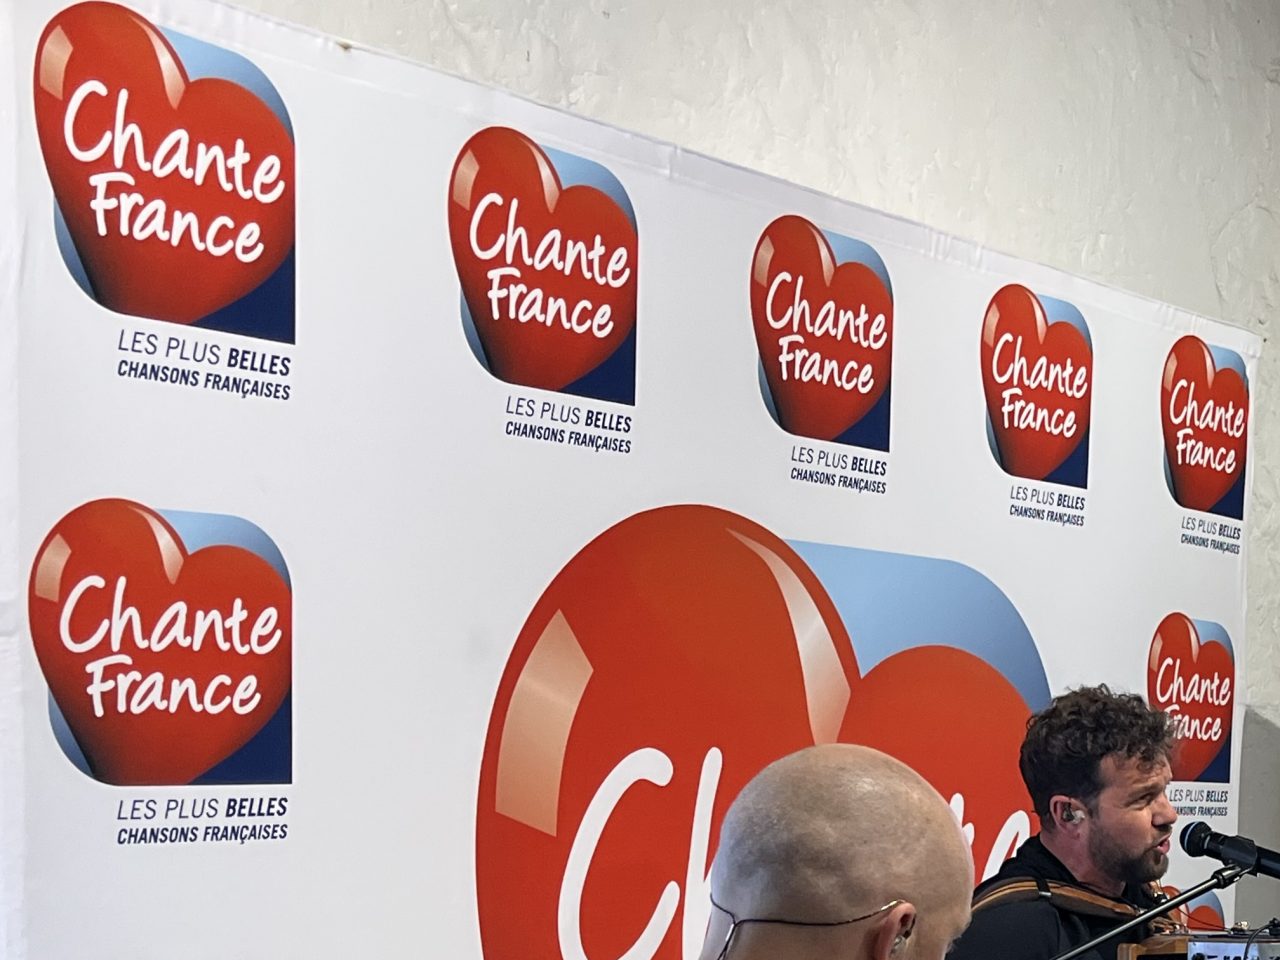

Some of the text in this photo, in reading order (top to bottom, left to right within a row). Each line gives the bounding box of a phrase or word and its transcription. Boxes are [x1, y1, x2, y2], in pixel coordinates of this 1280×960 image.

[64, 80, 285, 203] Chante
[89, 172, 264, 263] France
[469, 192, 630, 288] Chante
[487, 267, 614, 338] France
[766, 272, 888, 350] Chante
[118, 329, 291, 376] LES PLUS BELLES
[778, 334, 874, 394] France
[992, 332, 1088, 399] Chante
[117, 360, 290, 400] CHANSONS FRANÇAISES
[505, 396, 632, 433] LES PLUS BELLES
[1001, 387, 1077, 438] France
[1169, 379, 1245, 438] Chante
[505, 421, 632, 453] CHANSONS FRANÇAISES
[1176, 428, 1236, 474] France
[791, 446, 887, 476] LES PLUS BELLES
[791, 467, 886, 494] CHANSONS FRANÇAISES
[1010, 485, 1085, 511] LES PLUS BELLES
[1010, 504, 1084, 527] CHANSONS FRANÇAISES
[1181, 534, 1208, 548] CHANSONS
[1182, 516, 1241, 540] LES PLUS BELLES
[59, 575, 282, 655] Chante
[85, 654, 262, 718] France
[1156, 656, 1231, 706] Chante
[117, 797, 288, 820] LES PLUS BELLES
[1169, 789, 1228, 803] LES PLUS BELLES
[117, 824, 288, 845] CHANSONS FRANÇAISES
